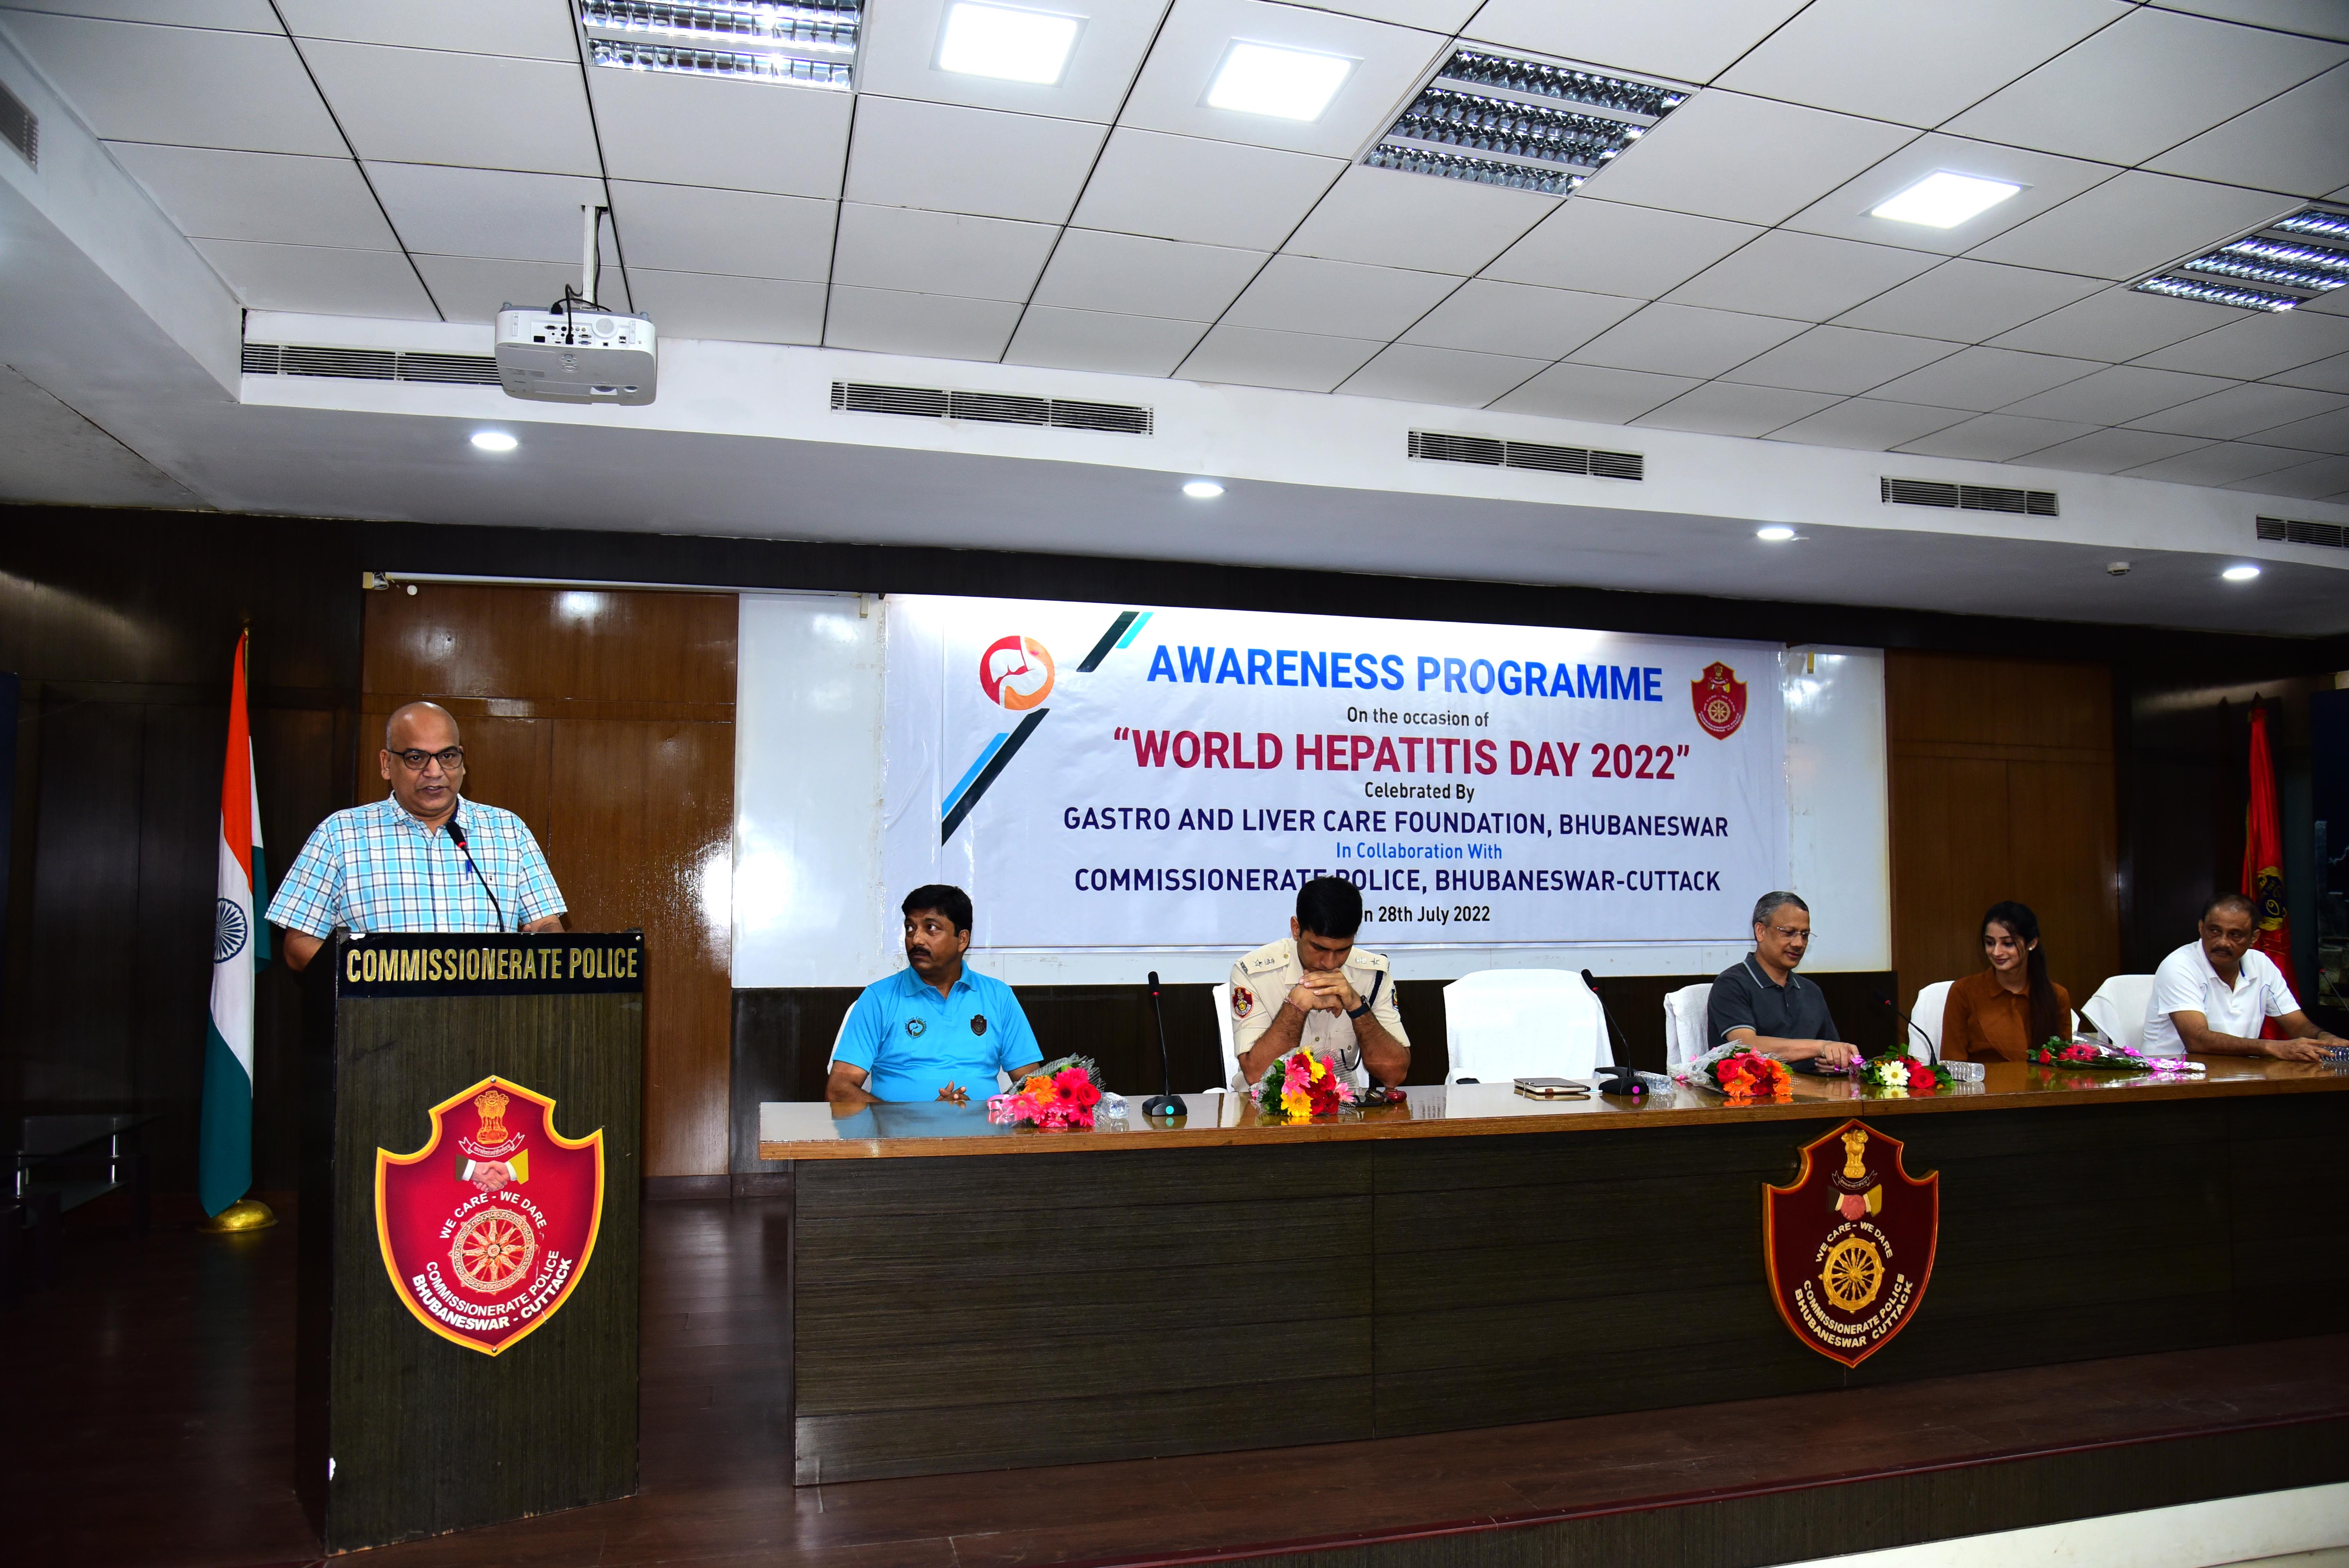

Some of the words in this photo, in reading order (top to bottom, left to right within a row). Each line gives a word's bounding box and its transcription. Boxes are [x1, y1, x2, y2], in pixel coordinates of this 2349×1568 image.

[1147, 645, 1404, 691] AWARENESS
[1417, 656, 1663, 702] PROGRAMME
[1347, 706, 1367, 723] On
[1373, 707, 1398, 724] the
[1403, 713, 1469, 726] occasion
[1475, 712, 1489, 727] of
[1114, 727, 1283, 769] “WORLD
[1296, 734, 1497, 775] HEPATITIS
[1510, 740, 1581, 777] DAY
[1591, 743, 1690, 780] 2022”
[1365, 782, 1451, 799] Celebrated
[1456, 784, 1475, 804] By
[1064, 807, 1170, 830] GASTRO
[1178, 808, 1233, 830] AND
[1243, 809, 1315, 831] LIVER
[1324, 810, 1387, 832] CARE
[1395, 811, 1552, 839] FOUNDATION,
[1560, 814, 1729, 837] BHUBANESWAR
[1337, 842, 1351, 858] In
[1357, 842, 1463, 859] Collaboration
[1467, 843, 1502, 859] With
[1436, 870, 1721, 891] BHUBANESWAR-CUTTACK
[1378, 906, 1412, 922] 28th
[1417, 906, 1449, 926] July
[1454, 905, 1490, 922] 2022
[346, 948, 562, 982] COMMISSIONERATE
[569, 948, 638, 979] POLICE
[439, 1218, 457, 1238] WE
[454, 1193, 488, 1218] CARE
[501, 1191, 520, 1204] WE
[520, 1198, 547, 1229] DARE
[1816, 1242, 1828, 1262] WE
[1827, 1222, 1851, 1242] CARE
[1860, 1221, 1874, 1233] WE
[1874, 1229, 1893, 1258] DARE
[412, 1274, 510, 1331] BHUBANESWAR
[520, 1258, 572, 1319] CUTTACK
[426, 1262, 530, 1316] COMMISSIONERATE
[528, 1250, 560, 1296] POLICE
[1795, 1288, 1867, 1347] BHUBANESWAR
[1872, 1280, 1913, 1339] CUTTACK
[1804, 1280, 1880, 1335] COMMISSIONERATE
[1879, 1274, 1904, 1319] POLICE
